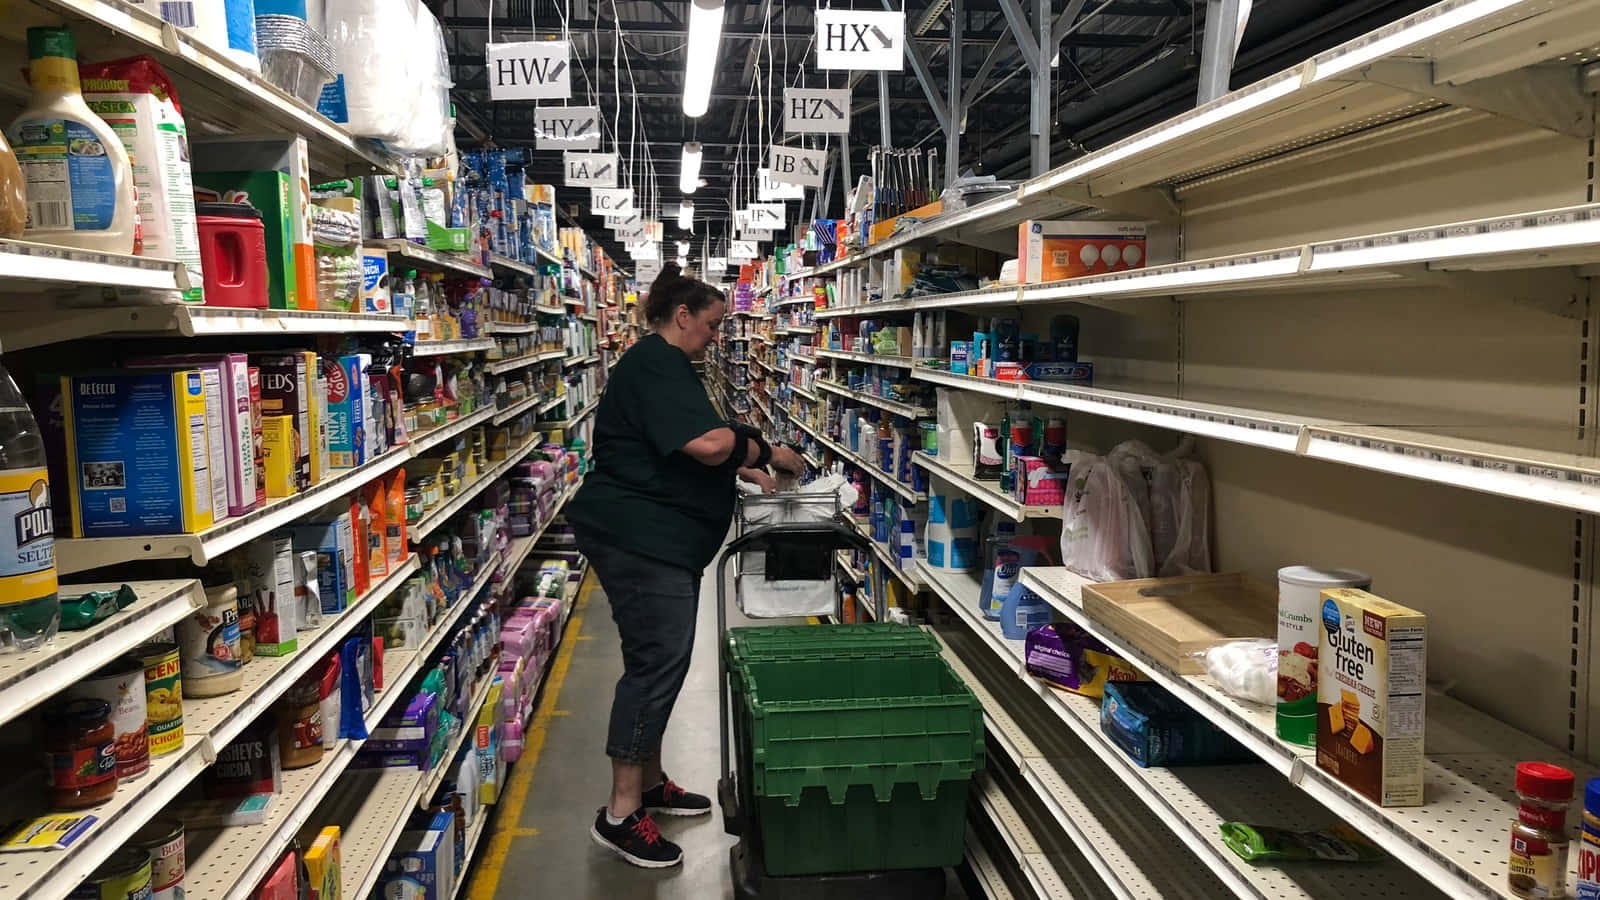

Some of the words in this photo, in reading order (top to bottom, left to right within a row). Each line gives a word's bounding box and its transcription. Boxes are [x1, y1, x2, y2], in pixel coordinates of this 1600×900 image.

[825, 23, 870, 52] HX
[496, 57, 550, 86] HW
[791, 98, 824, 119] HZ
[542, 119, 574, 140] HY
[569, 162, 590, 179] IA
[775, 154, 796, 173] IB
[596, 195, 611, 209] IC
[752, 209, 765, 222] IF
[260, 374, 294, 392] TEDS
[328, 411, 340, 444] MINI
[1328, 626, 1374, 665] Gluten
[1336, 646, 1364, 681] free
